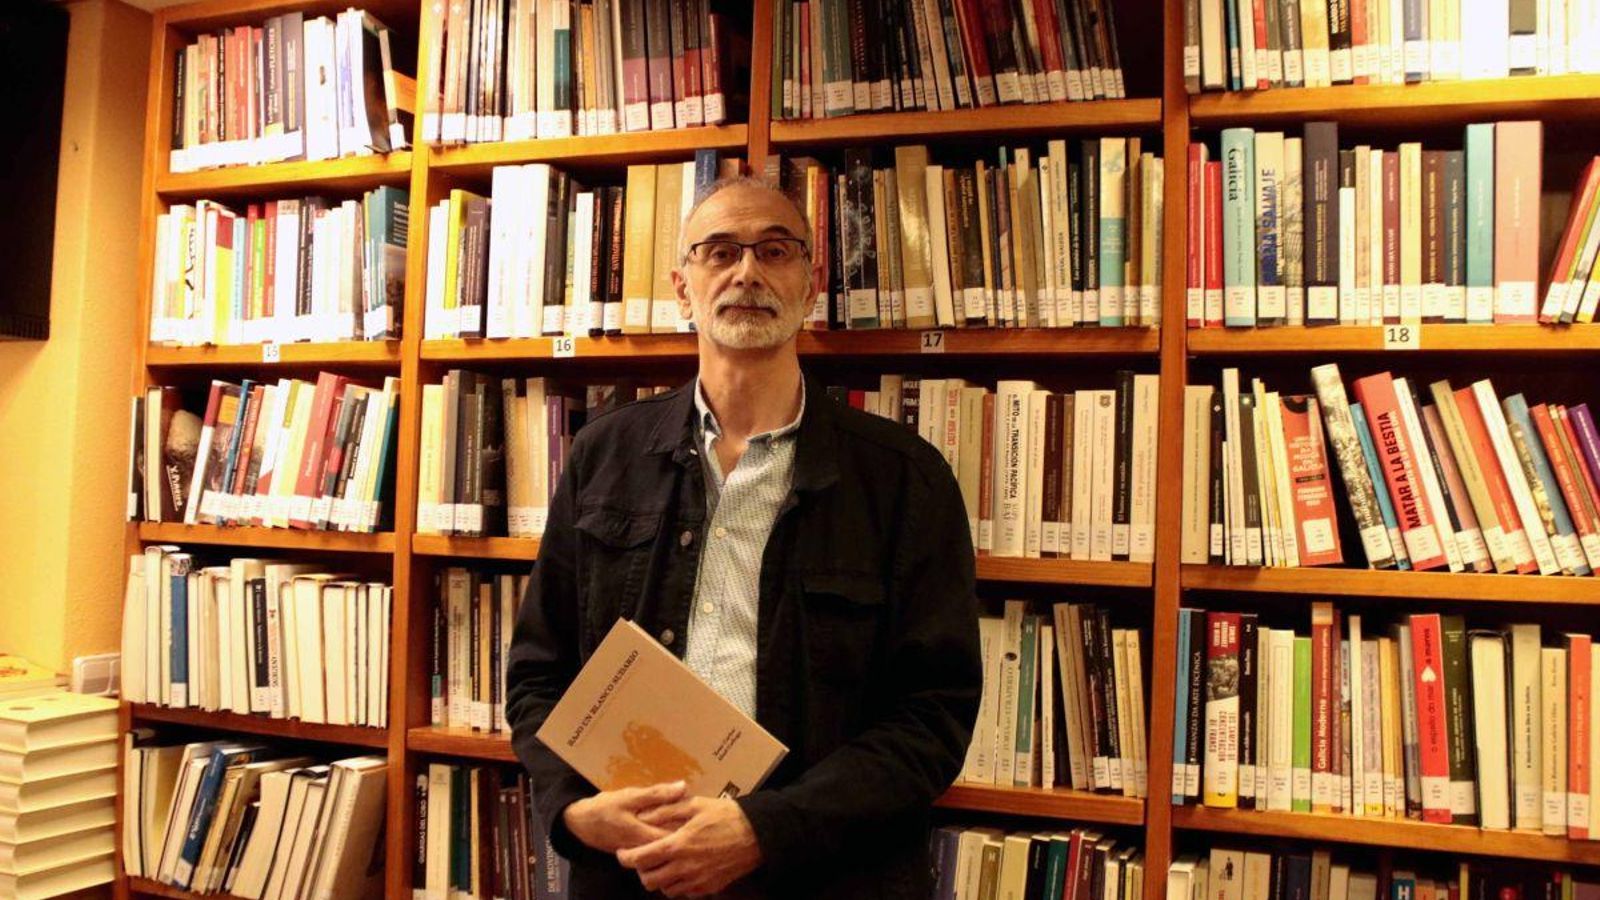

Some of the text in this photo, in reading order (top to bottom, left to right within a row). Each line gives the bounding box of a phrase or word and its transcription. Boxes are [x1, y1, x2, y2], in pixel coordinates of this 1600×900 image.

[1228, 148, 1242, 201] Galicia
[1261, 169, 1277, 228] SALVAJE
[556, 339, 572, 351] 16
[923, 333, 943, 347] 17
[1388, 328, 1411, 344] 18
[1012, 400, 1020, 416] MITO
[1010, 429, 1019, 467] TRANSICIÓN
[1010, 469, 1018, 499] PACÍFICA
[1378, 411, 1422, 529] MATAR A LA BESTIA
[566, 725, 585, 748] BAJO
[581, 713, 594, 727] UN
[589, 683, 616, 716] BLANCO
[1192, 706, 1198, 717] DA
[1318, 699, 1327, 737] Moderna
[1428, 702, 1435, 713] do
[1209, 719, 1217, 753] DE FRANCO
[1318, 738, 1327, 769] Galicia
[547, 880, 555, 892] DE
